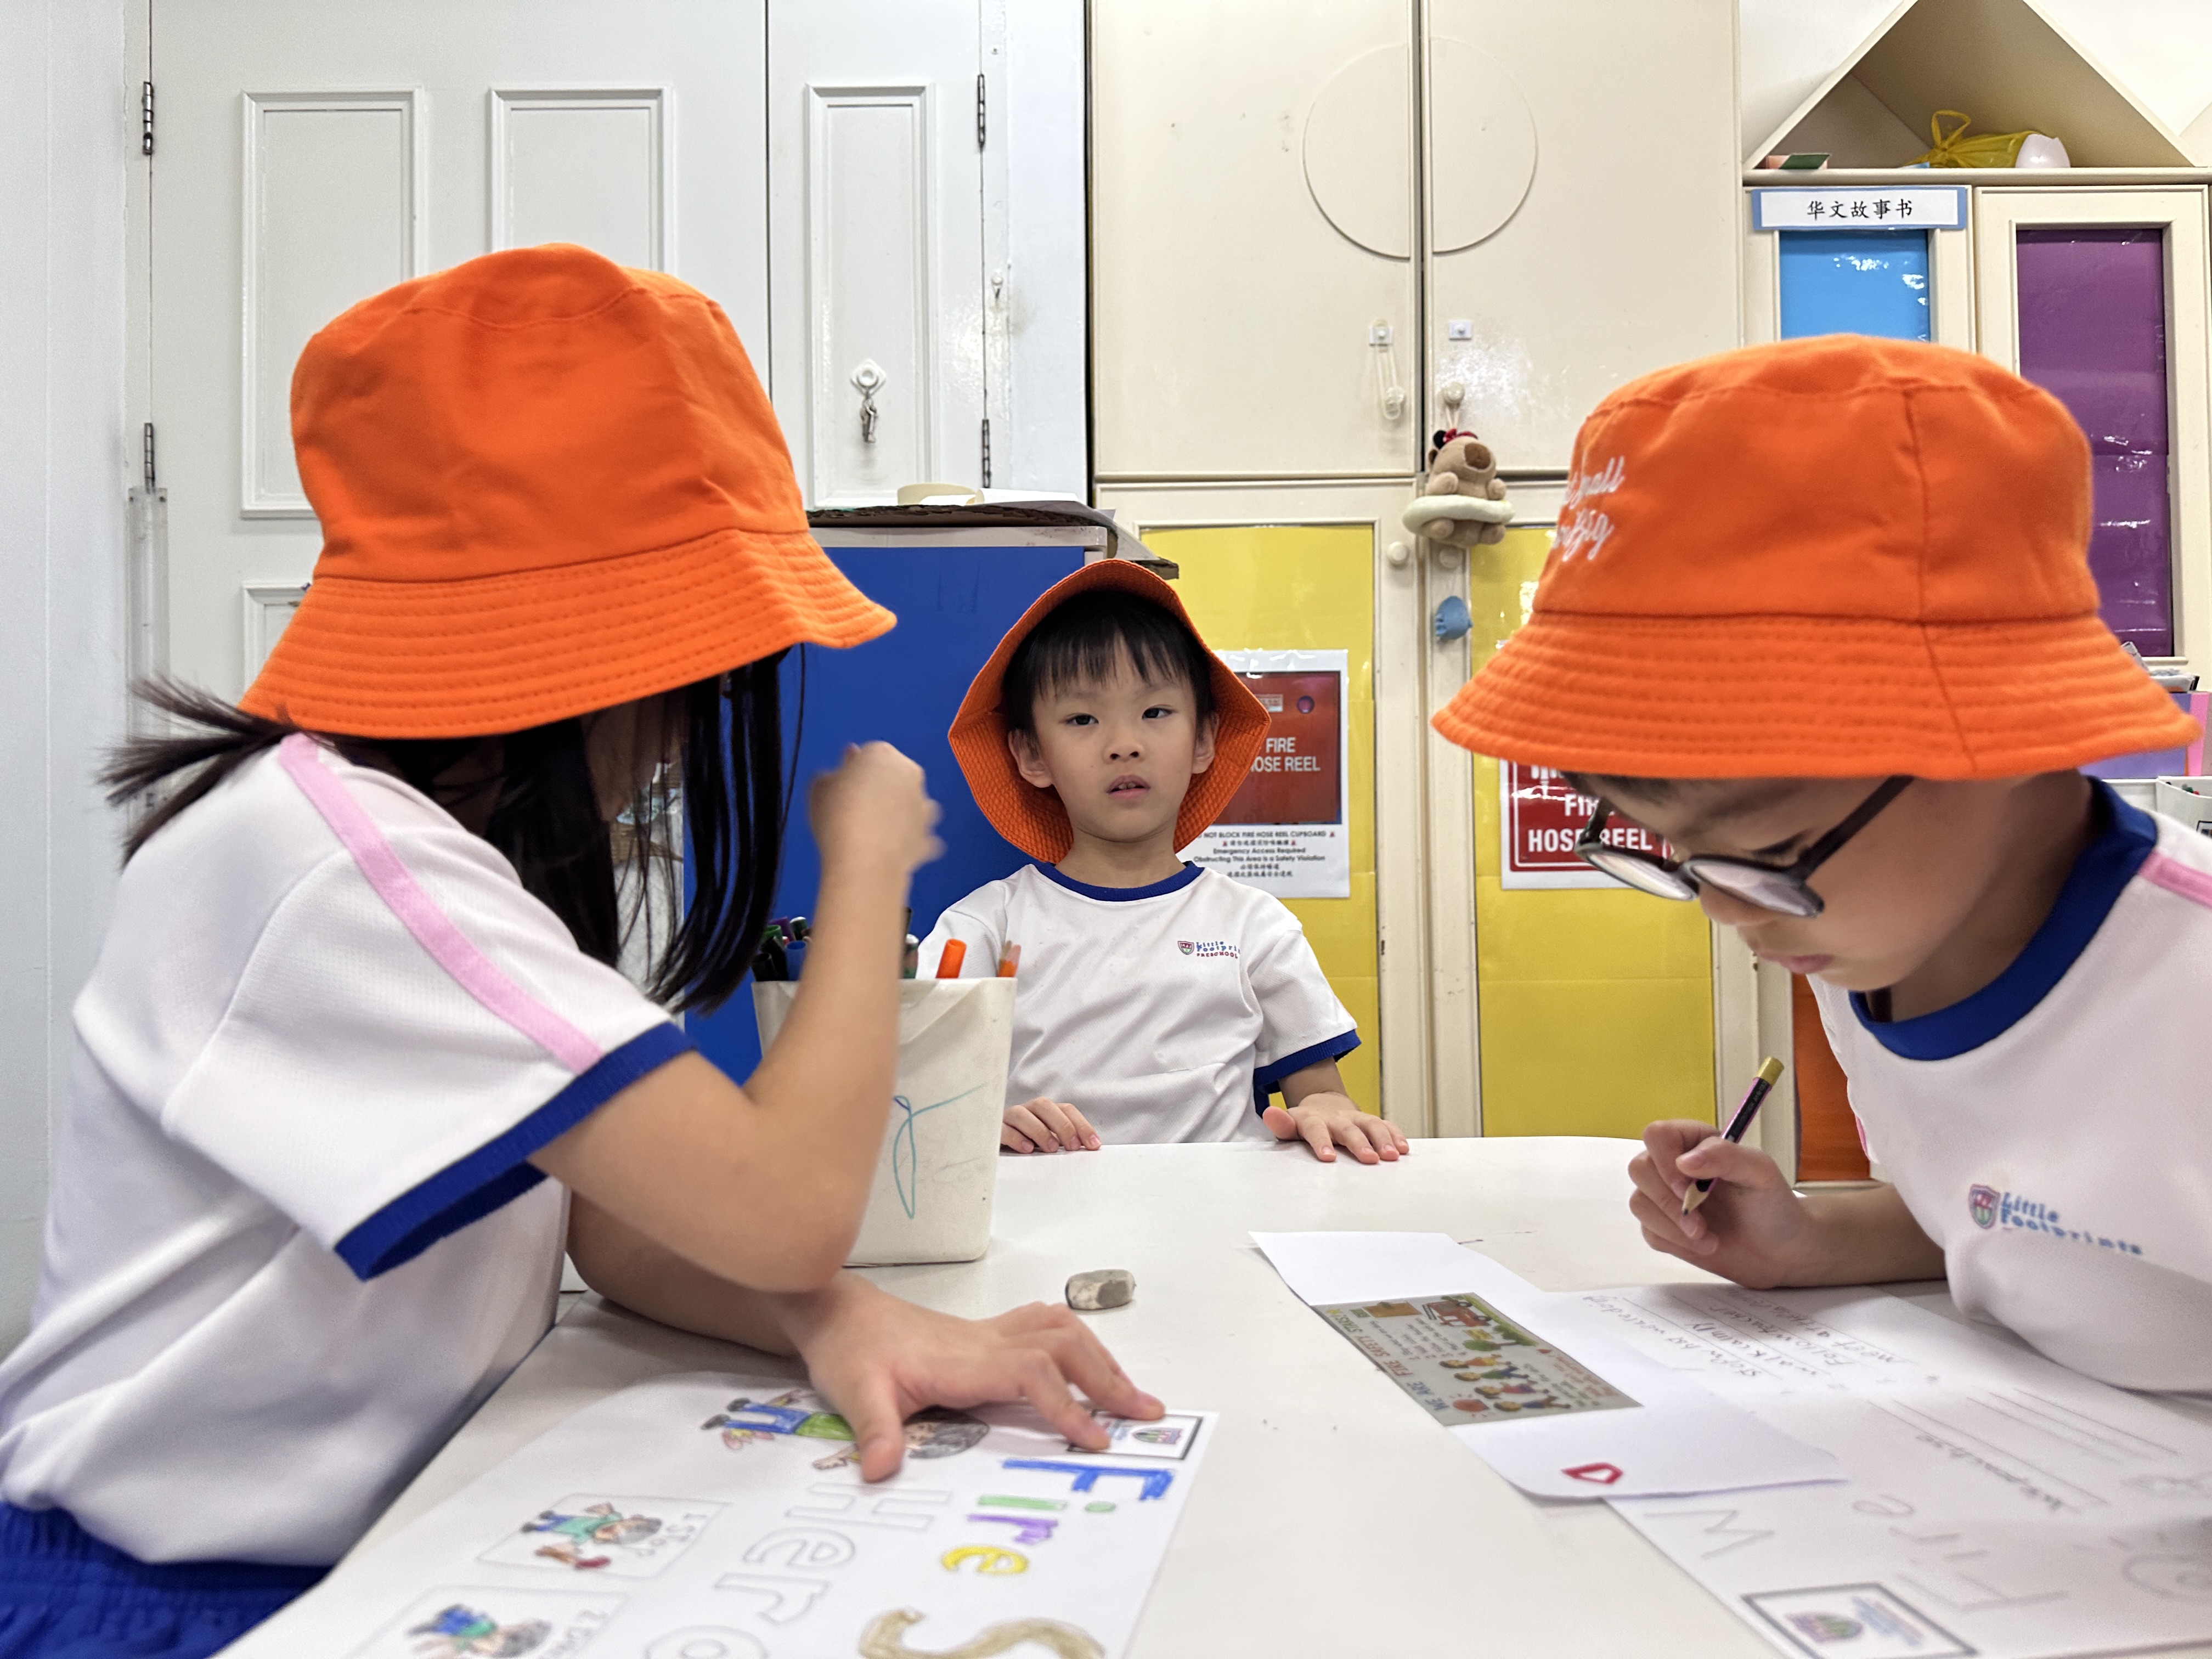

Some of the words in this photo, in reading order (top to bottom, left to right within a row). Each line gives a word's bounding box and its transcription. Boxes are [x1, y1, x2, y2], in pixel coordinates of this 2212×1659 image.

[1807, 198, 1913, 221] 华文故事书
[1266, 737, 1296, 753] FIRE
[1251, 755, 1282, 772] OSE
[1284, 756, 1321, 772] REEL
[1565, 794, 1616, 816] FIR
[2002, 1192, 2059, 1223] Little
[1356, 1335, 1390, 1357] SAFETY
[1384, 1361, 1413, 1376] FIRE
[1407, 1381, 1435, 1395] ARE
[1425, 1398, 1449, 1410] WE
[941, 1457, 1176, 1576] Fire
